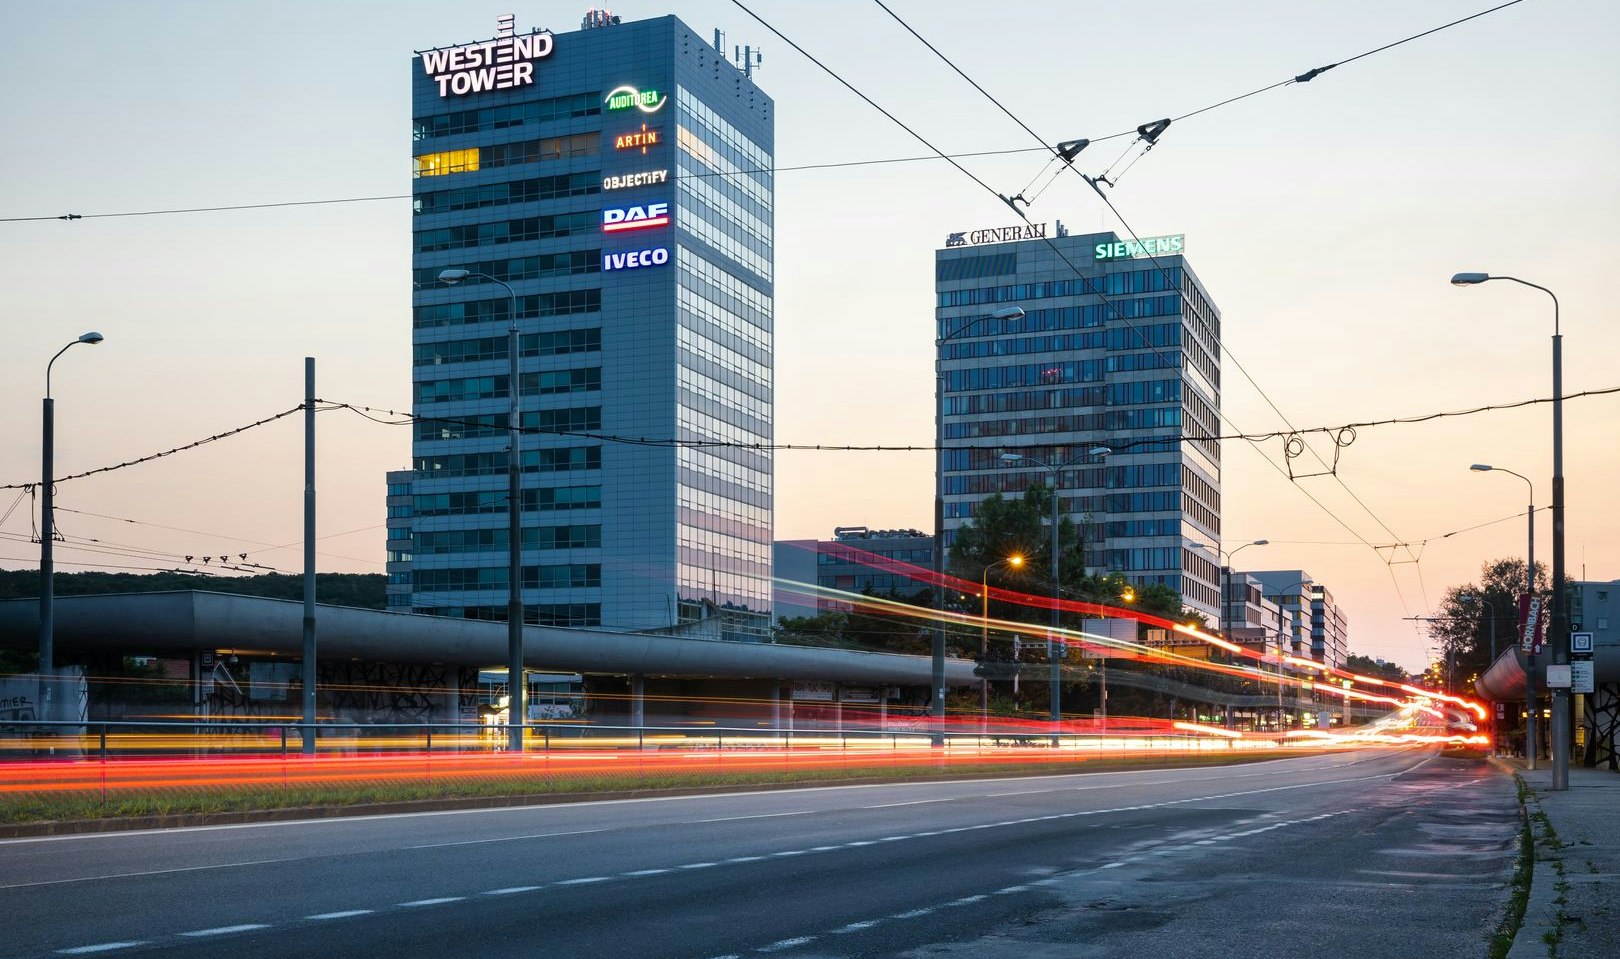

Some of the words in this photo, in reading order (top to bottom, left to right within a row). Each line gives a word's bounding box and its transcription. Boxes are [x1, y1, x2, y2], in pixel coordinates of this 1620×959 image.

[422, 33, 553, 75] WESTEND
[434, 61, 534, 97] TOWER
[609, 90, 658, 109] AUDITOREA
[603, 202, 668, 224] DAF
[970, 222, 1047, 245] GENERALI
[604, 248, 669, 270] IVECO
[1095, 236, 1182, 259] SIEMENS
[1521, 596, 1541, 651] HORNBACH
